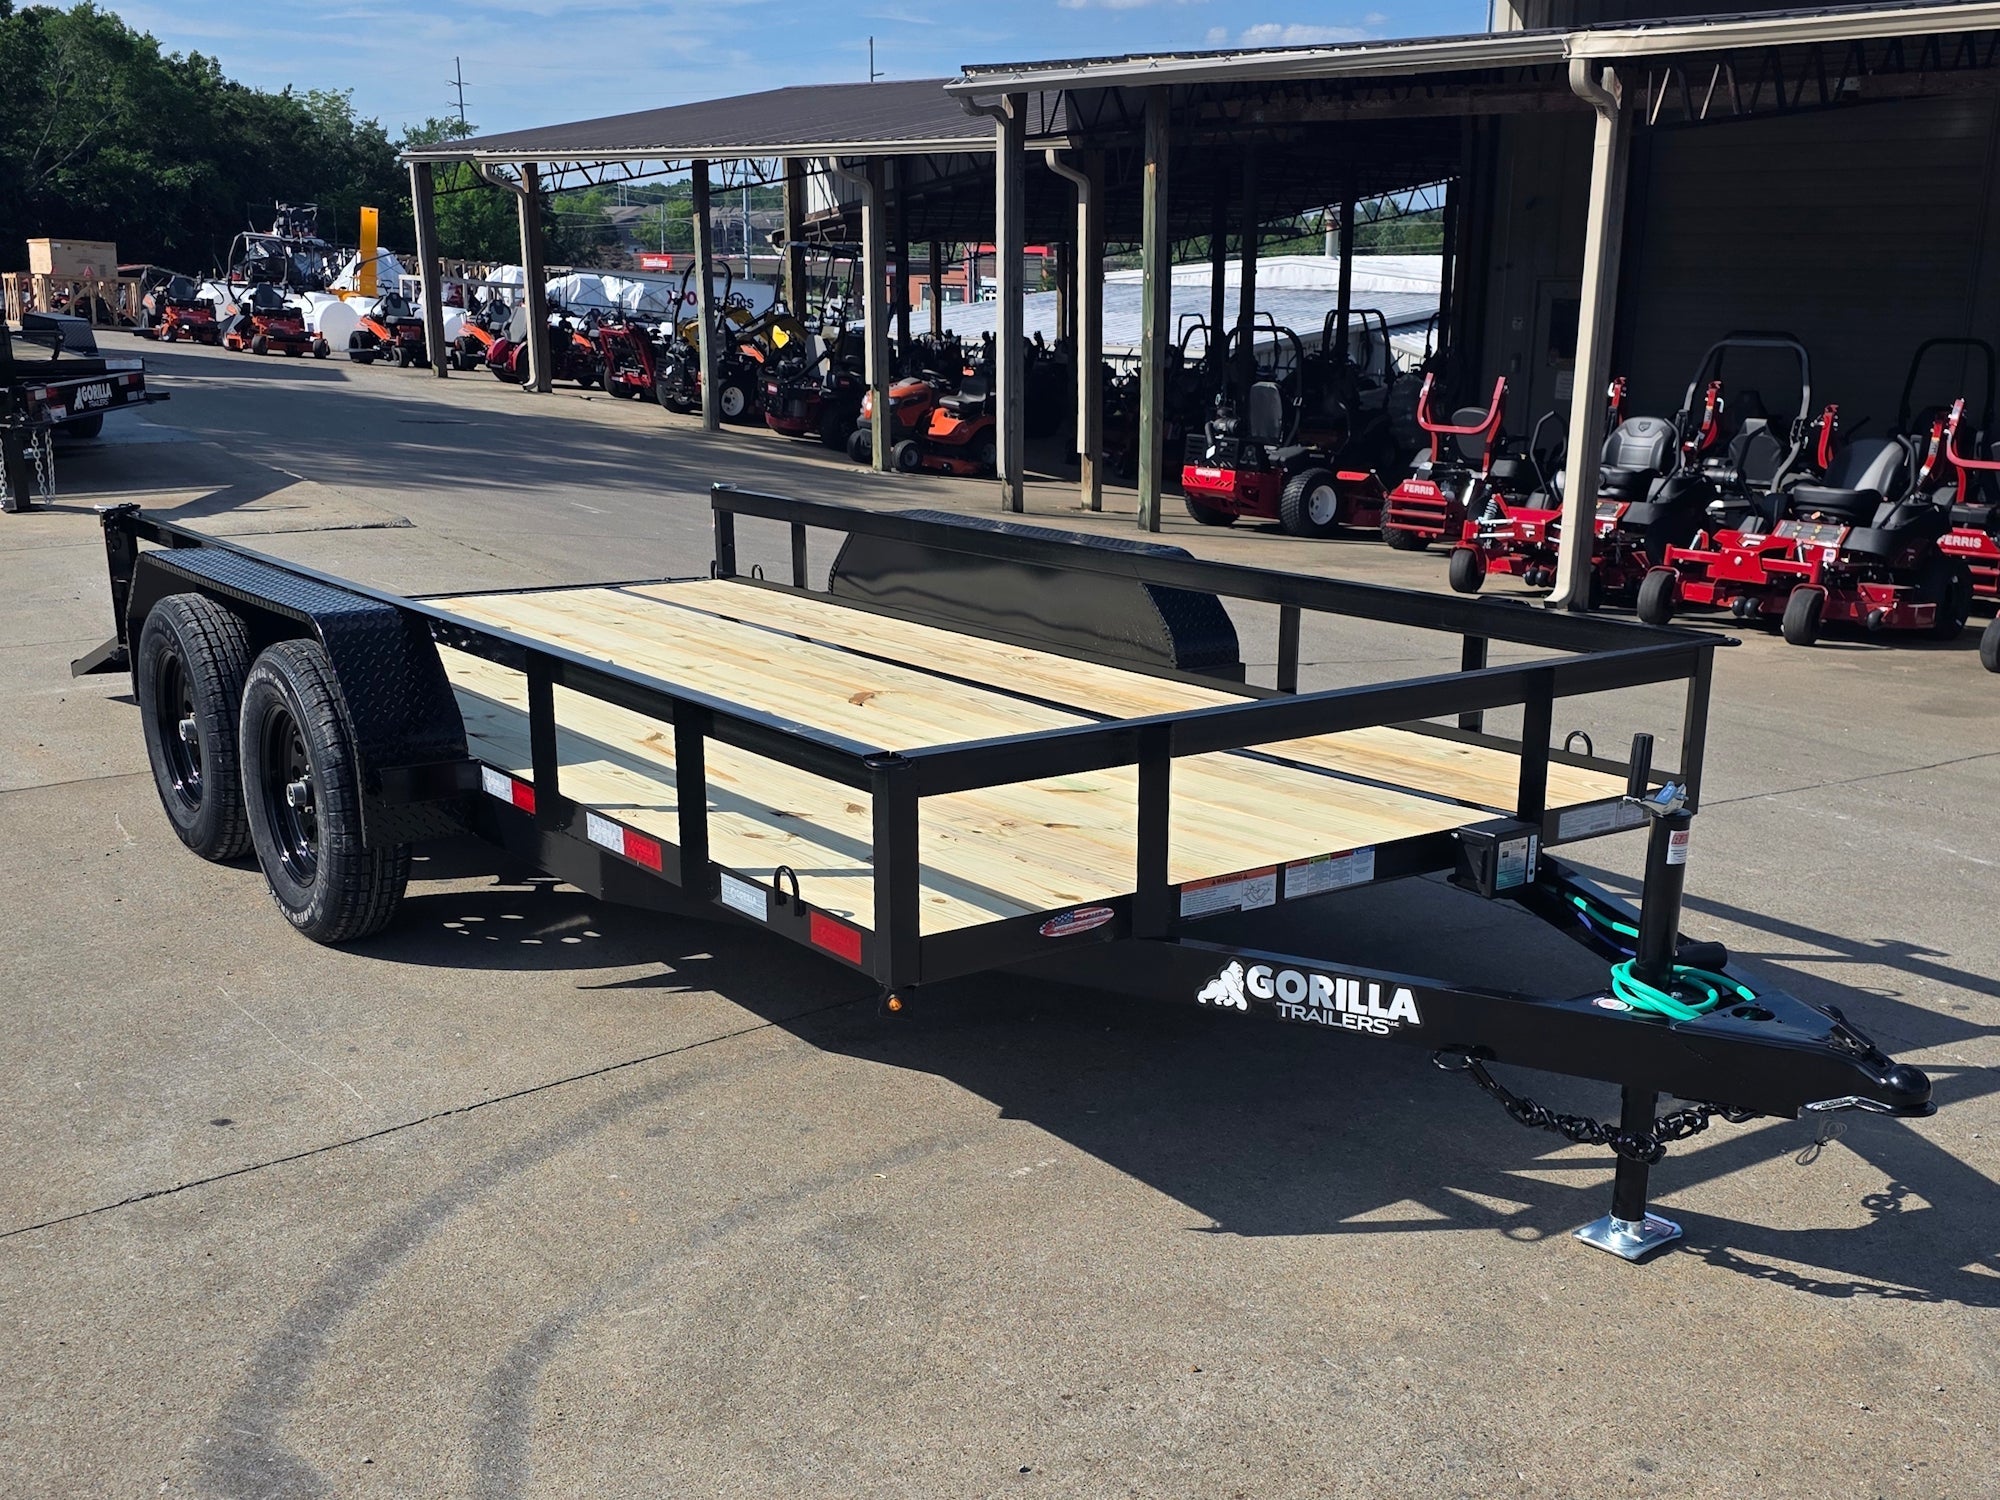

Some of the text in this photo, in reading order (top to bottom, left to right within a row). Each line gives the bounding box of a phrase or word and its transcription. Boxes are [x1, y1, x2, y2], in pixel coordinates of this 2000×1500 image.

[81, 382, 113, 402] GORILLA
[1403, 483, 1435, 496] FERRIS
[1936, 534, 1982, 549] FERRIS
[1246, 965, 1421, 1025] GORILLA
[1276, 1001, 1389, 1035] TRAILERS
